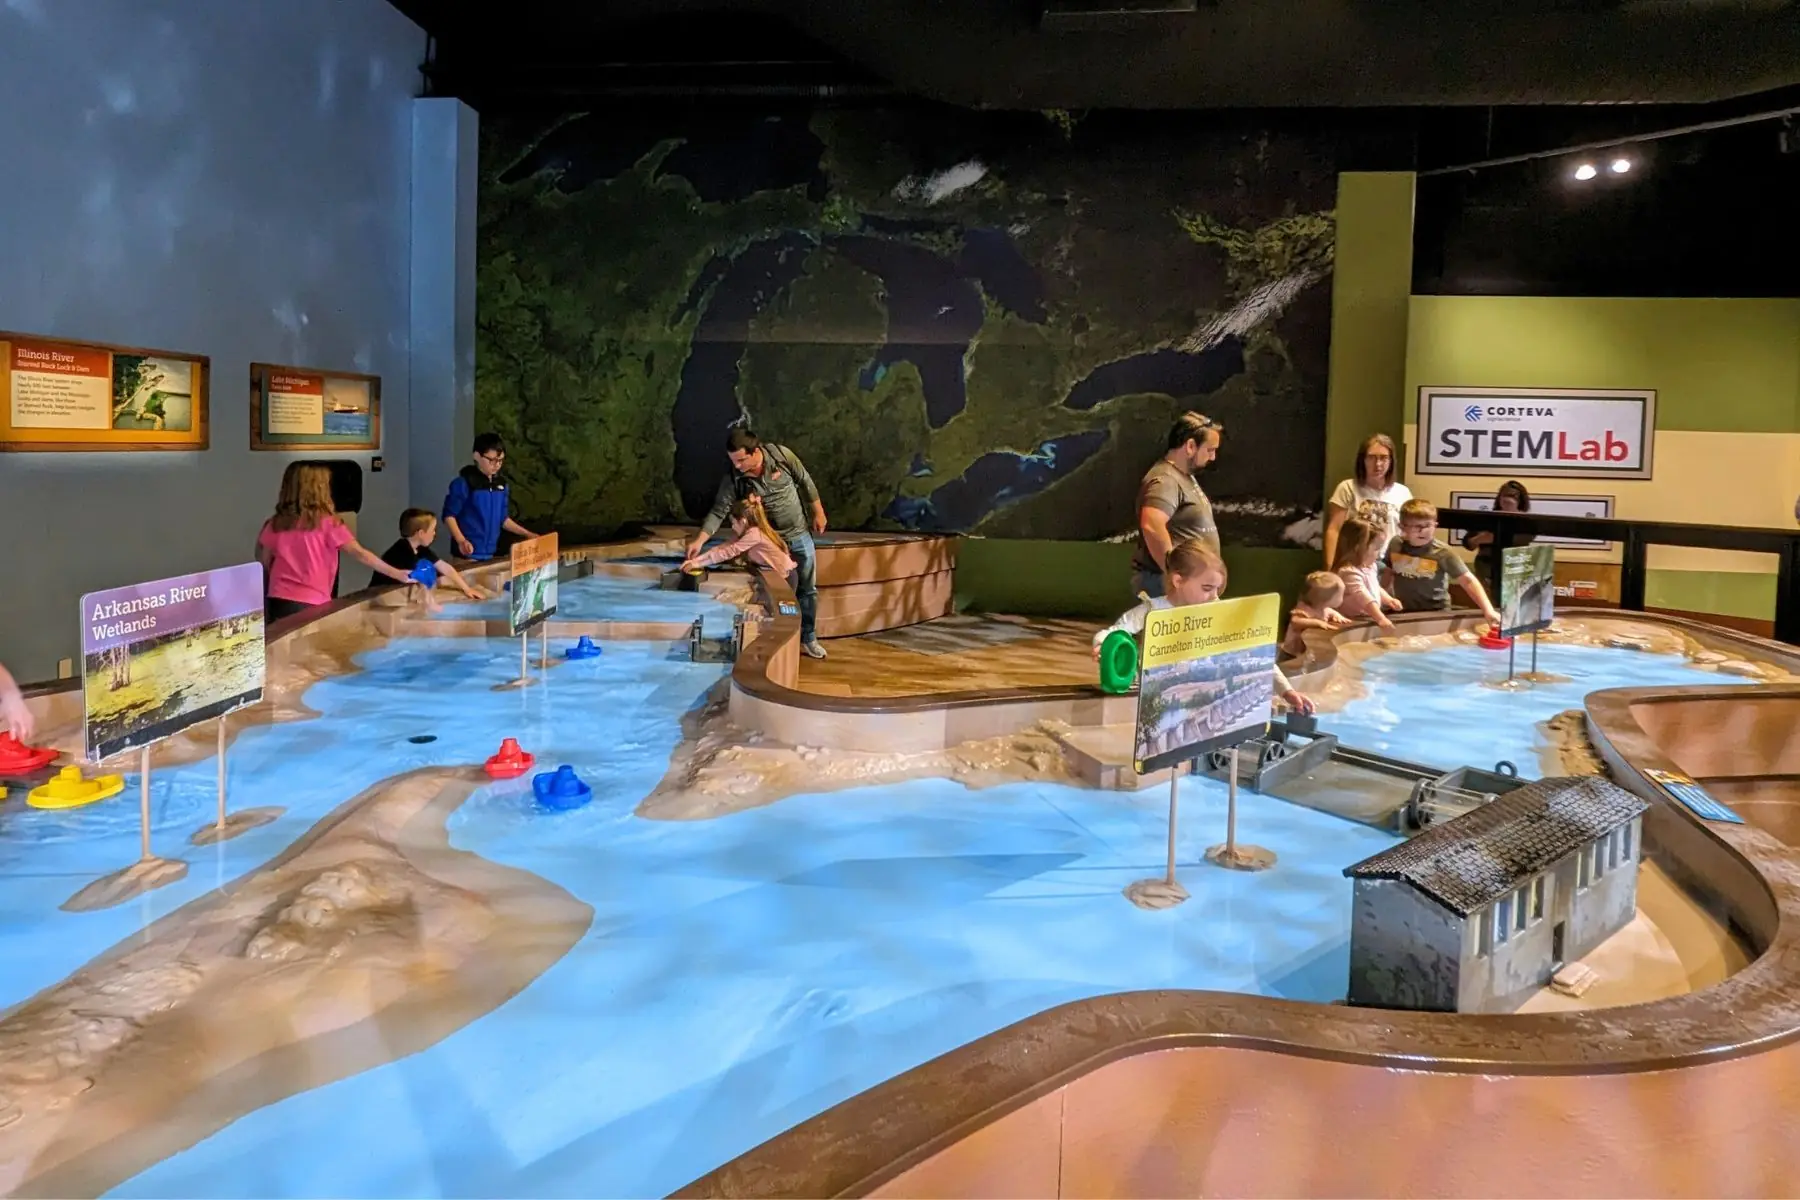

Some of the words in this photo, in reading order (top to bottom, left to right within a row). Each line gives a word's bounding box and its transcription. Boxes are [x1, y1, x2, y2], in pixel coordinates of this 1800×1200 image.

[17, 348, 50, 360] Illinois
[51, 352, 75, 363] River
[1487, 407, 1554, 417] CORTEVA
[1439, 428, 1629, 462] STEMLab
[92, 594, 166, 621] Arkansas
[170, 584, 208, 605] River
[92, 614, 157, 641] Wetlands
[1151, 620, 1181, 637] Ohio
[1183, 616, 1213, 633] River
[1149, 640, 1193, 657] Cannelton
[1194, 630, 1246, 651] Hydroelectric
[1246, 624, 1273, 639] Facility
